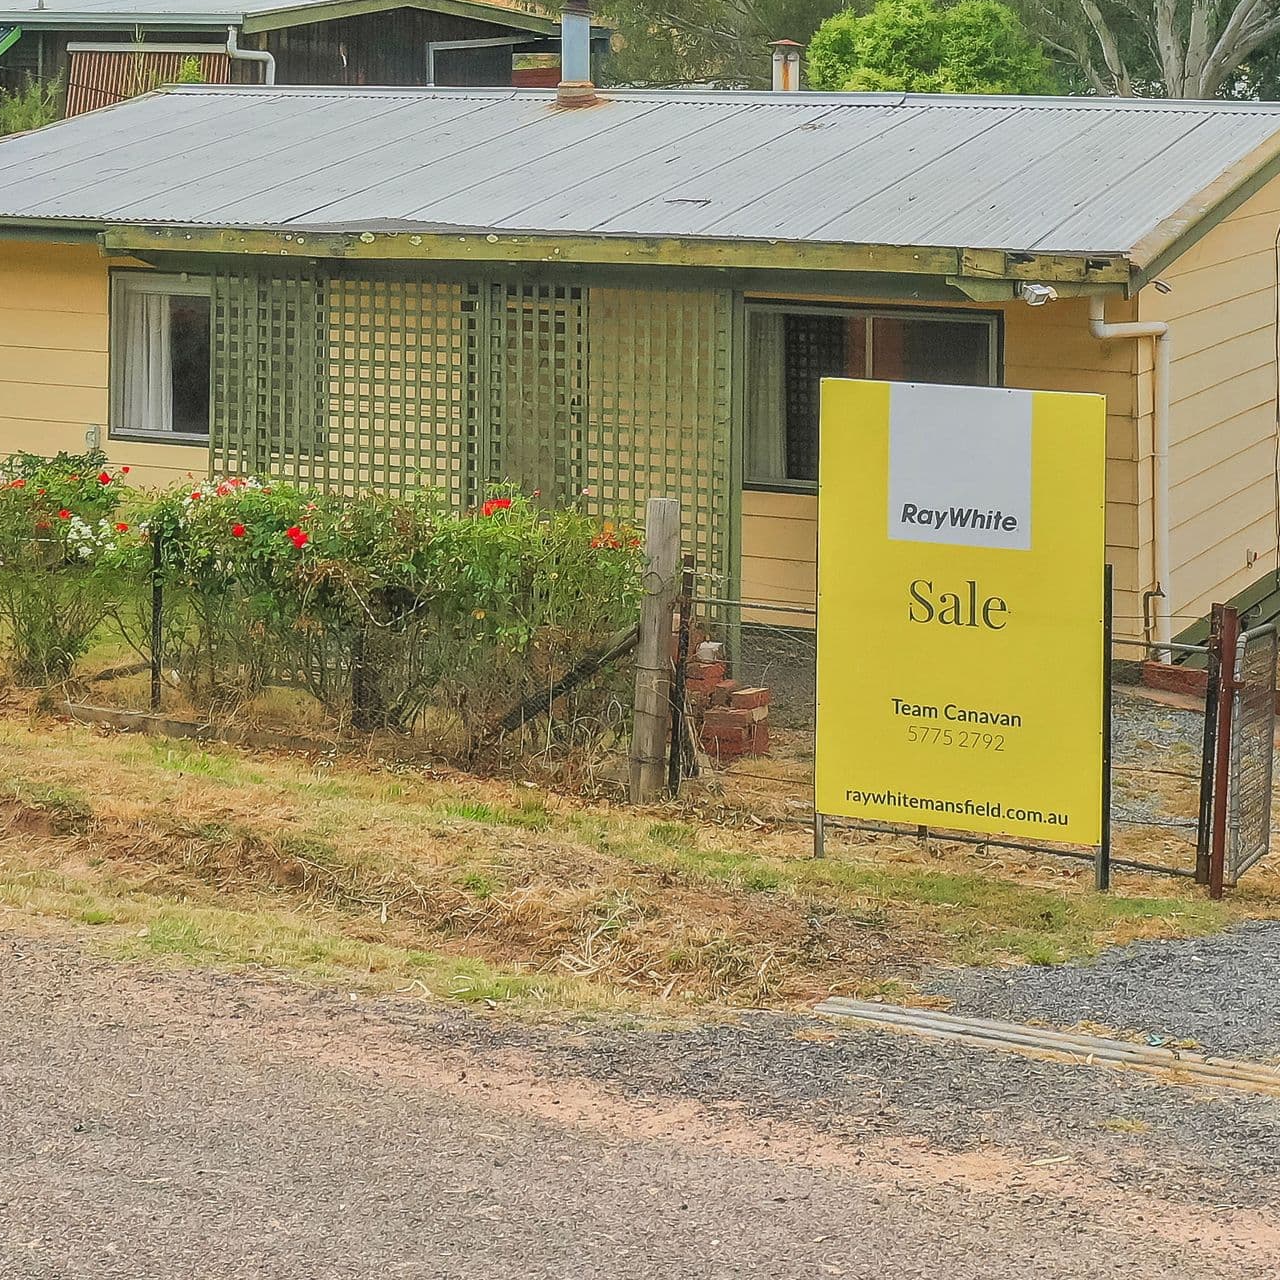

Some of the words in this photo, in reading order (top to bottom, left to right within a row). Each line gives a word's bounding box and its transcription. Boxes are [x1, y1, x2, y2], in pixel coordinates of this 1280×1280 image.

[908, 579, 1008, 630] Sale
[891, 698, 938, 719] Team
[944, 704, 1022, 727] Canavan
[908, 725, 953, 746] 5775
[959, 731, 1005, 751] 2792
[846, 789, 1069, 825] raywhitemansfield.com.au
